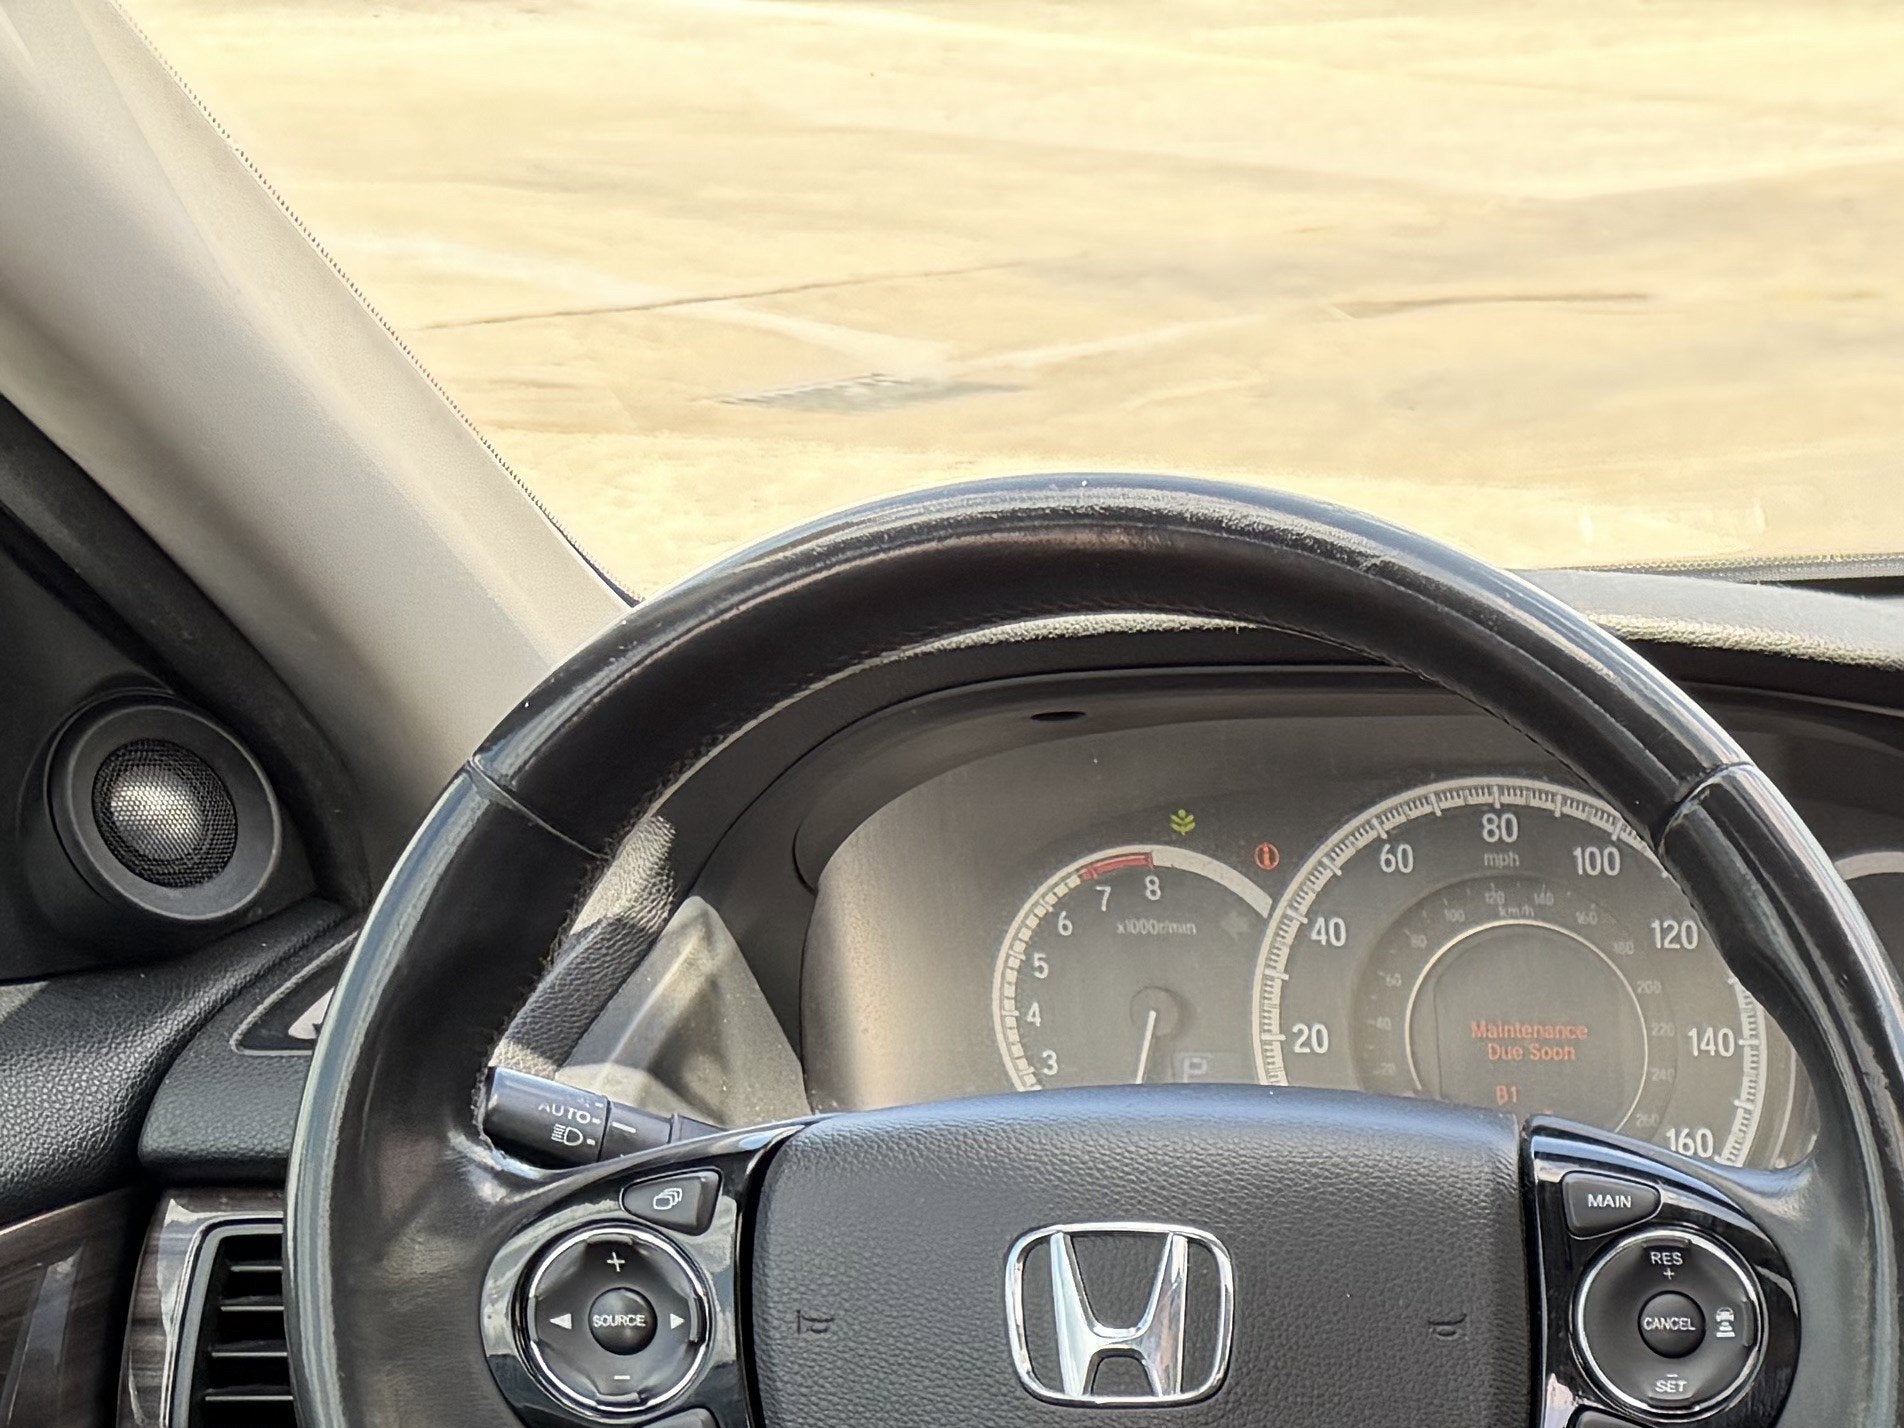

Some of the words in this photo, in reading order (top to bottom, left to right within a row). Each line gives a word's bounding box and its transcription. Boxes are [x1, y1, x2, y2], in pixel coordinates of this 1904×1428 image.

[1482, 812, 1518, 843] 80
[1380, 843, 1414, 873] 60
[1484, 852, 1520, 868] mph
[1573, 846, 1621, 876] 100
[1095, 886, 1112, 911] 7
[1143, 875, 1162, 901] 8
[1057, 910, 1073, 936] 6
[1309, 917, 1347, 947] 40
[1650, 919, 1699, 950] 120
[1033, 952, 1050, 980] 5
[1026, 1001, 1042, 1027] 4
[1291, 1023, 1330, 1054] 20
[1471, 1020, 1588, 1040] Maintenance
[1686, 1027, 1736, 1058] 140
[1041, 1050, 1059, 1076] 3
[1486, 1043, 1524, 1061] Due
[1529, 1043, 1576, 1061] Soon
[538, 1103, 592, 1124] AUTO
[1665, 1127, 1715, 1158] 160
[1587, 1193, 1632, 1208] MAIN
[1650, 1251, 1684, 1266] RES
[592, 1313, 646, 1328] SOURCE
[1643, 1317, 1697, 1332] CANCEL
[1654, 1380, 1688, 1394] SET
